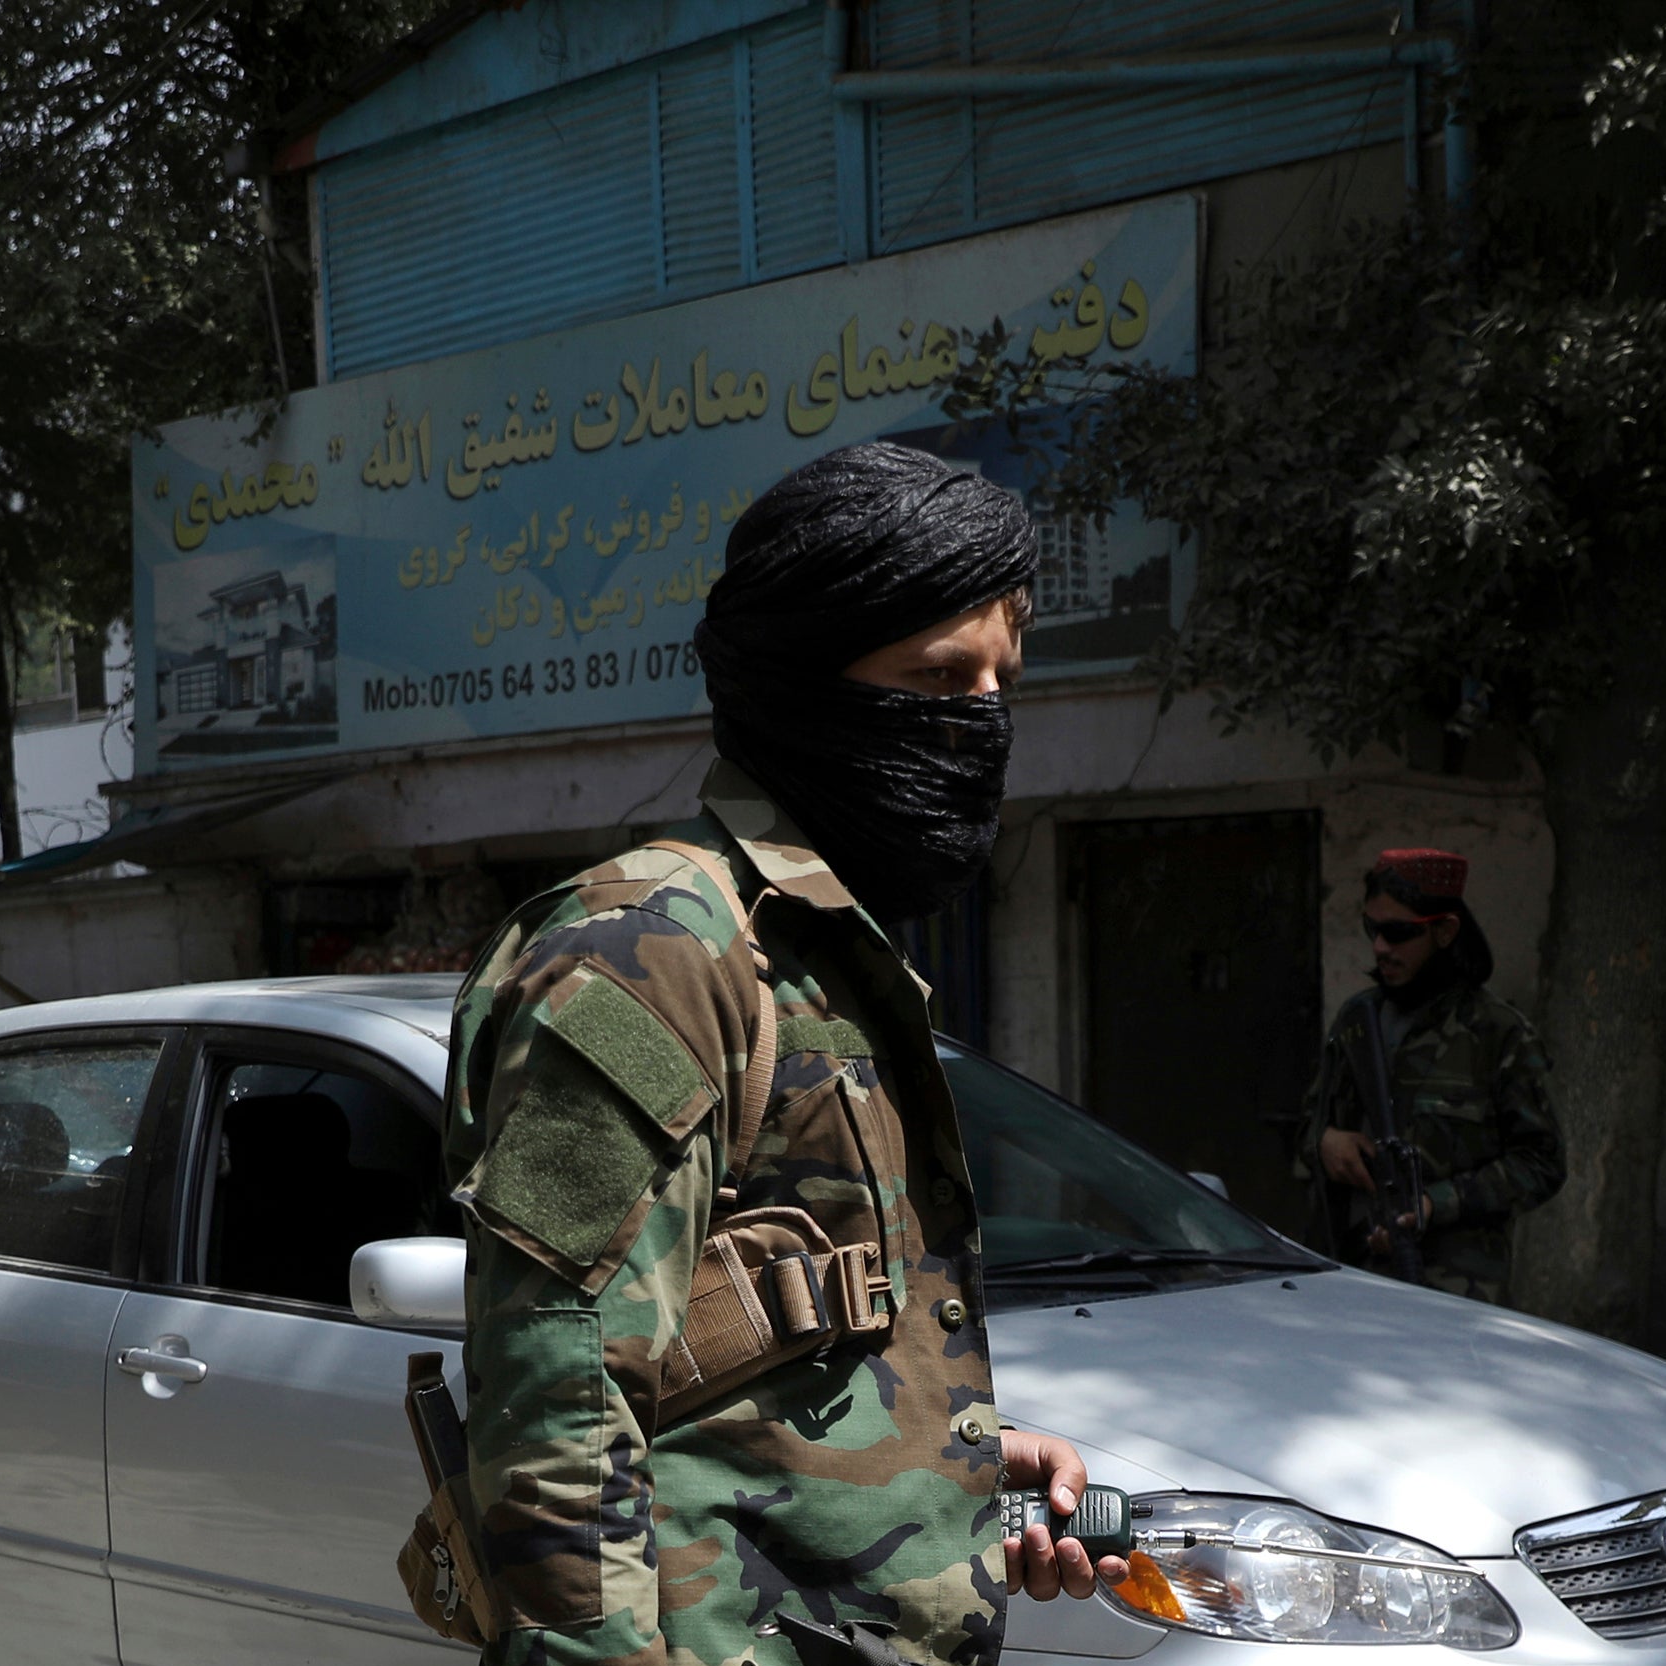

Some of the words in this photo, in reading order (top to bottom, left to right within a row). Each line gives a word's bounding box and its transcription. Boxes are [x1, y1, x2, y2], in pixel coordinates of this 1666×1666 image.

[362, 400, 431, 490] الله
[573, 348, 771, 452] معاملات
[502, 662, 535, 698] 64
[543, 657, 577, 694] 33
[585, 651, 620, 688] 83
